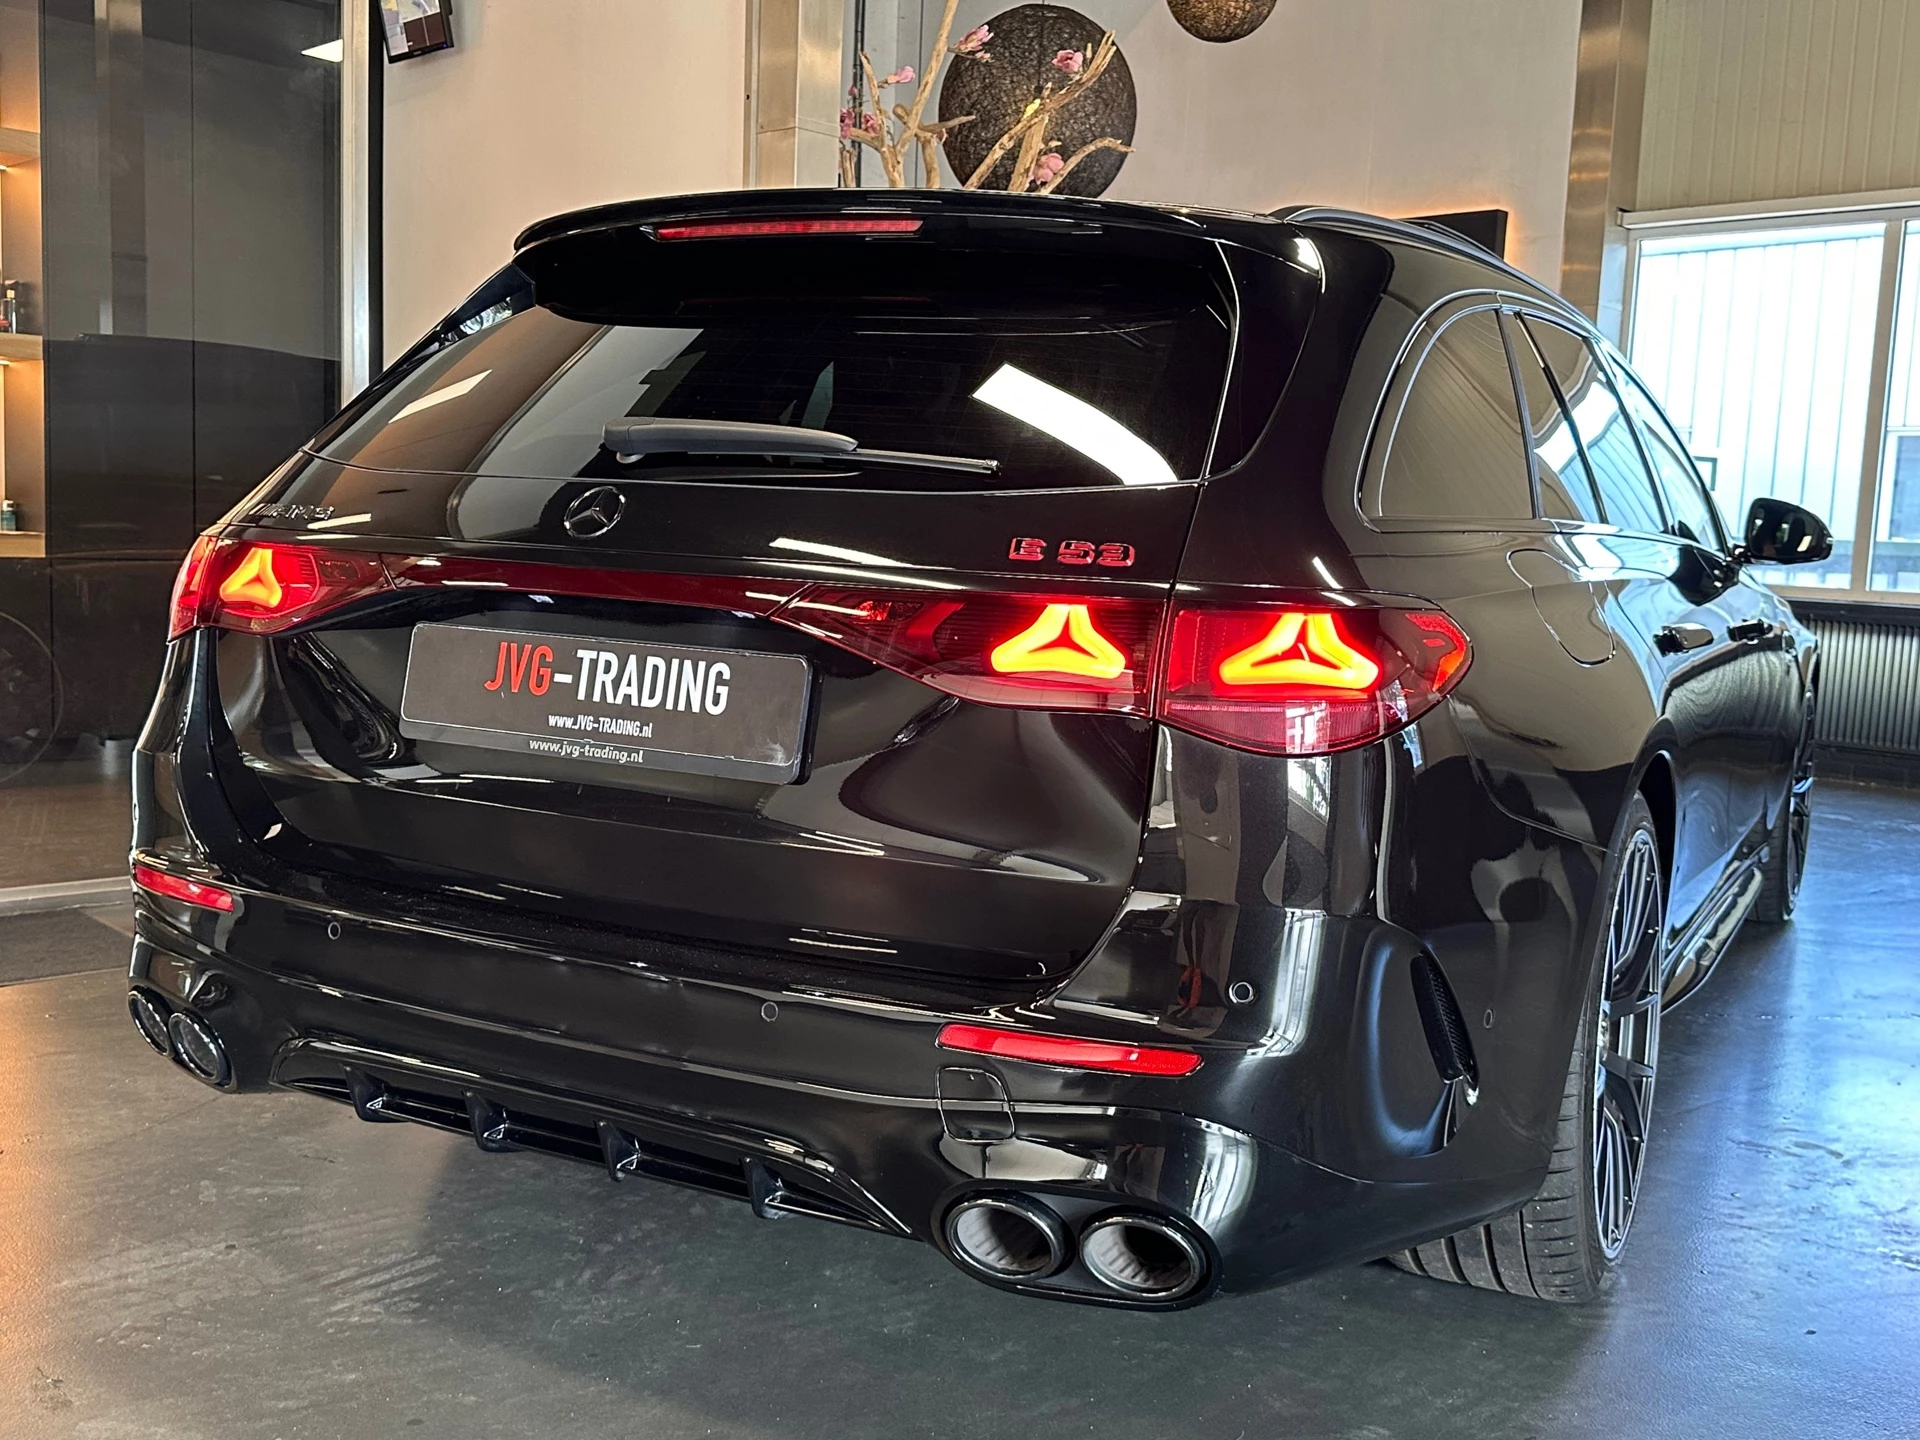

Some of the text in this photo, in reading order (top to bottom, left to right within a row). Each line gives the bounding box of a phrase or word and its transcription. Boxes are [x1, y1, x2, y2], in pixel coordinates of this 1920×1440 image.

[1009, 537, 1135, 567] E 53
[483, 641, 731, 716] JVG-TRADING
[548, 714, 653, 738] www.JVG-TRADING.nl
[529, 739, 643, 764] www.jvg-trading.nl
